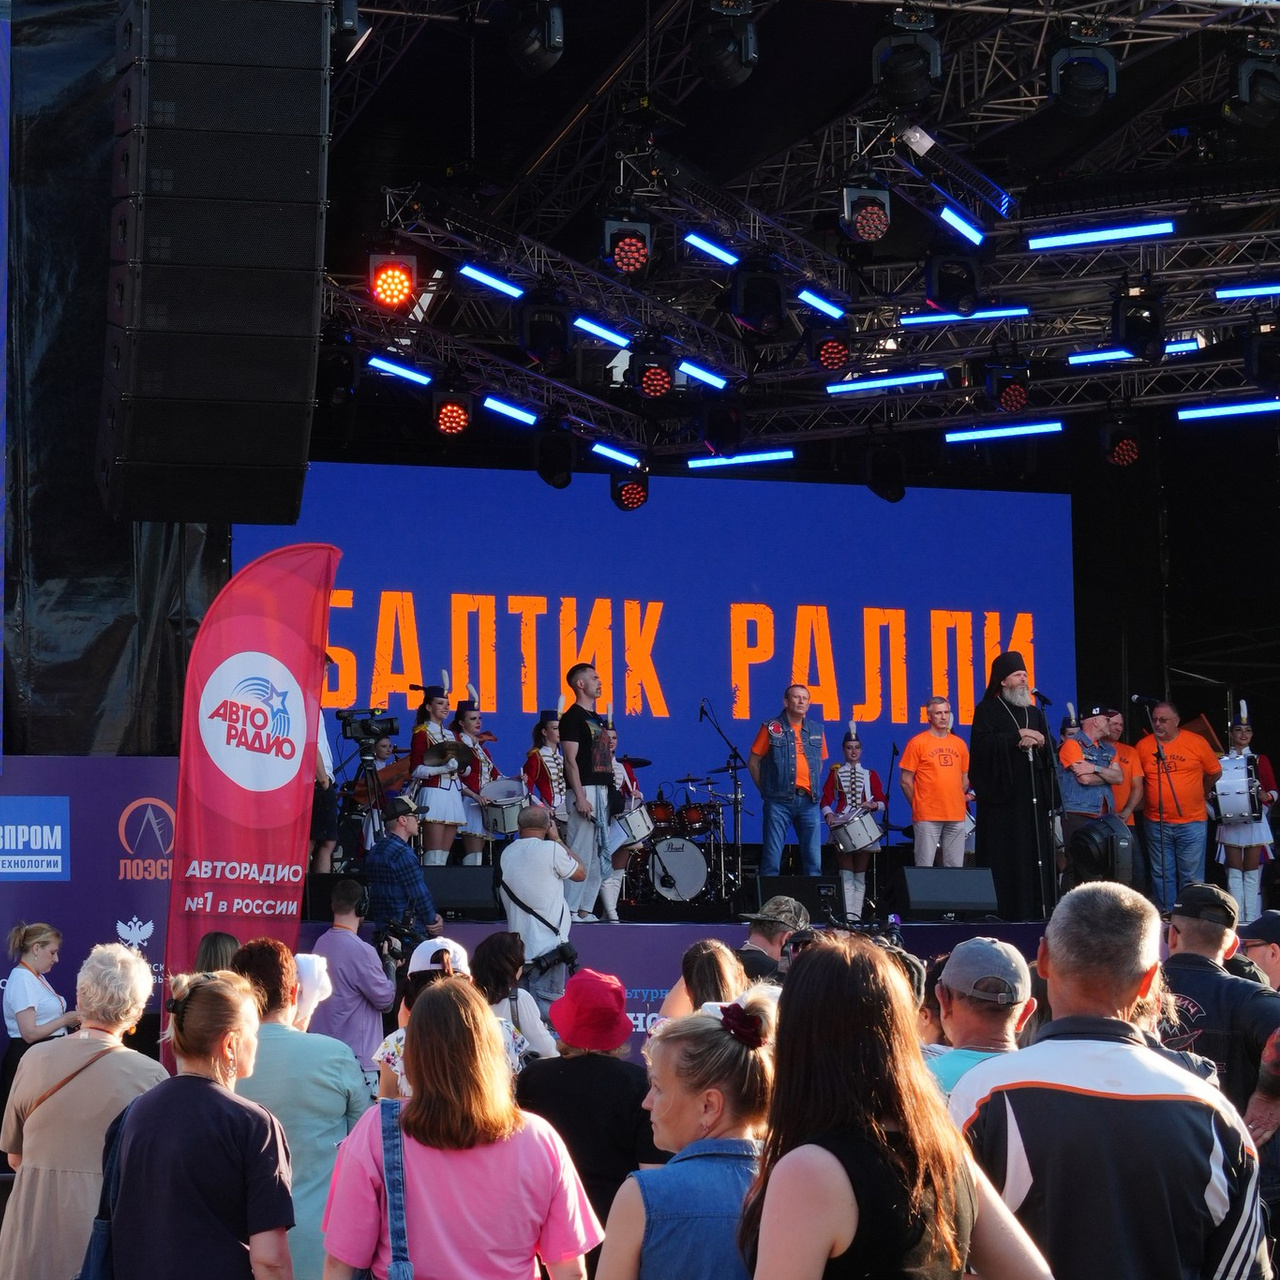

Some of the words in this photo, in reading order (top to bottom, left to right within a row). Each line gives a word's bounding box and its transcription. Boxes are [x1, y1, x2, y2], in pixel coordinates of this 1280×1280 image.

[322, 590, 670, 717] БАЛТИК
[730, 602, 1036, 726] РАЛЛИ
[207, 699, 268, 731] АВТО
[226, 723, 296, 761] РАДИО
[185, 859, 303, 884] АВТОРАДИО
[233, 897, 298, 916] РОССИИ
